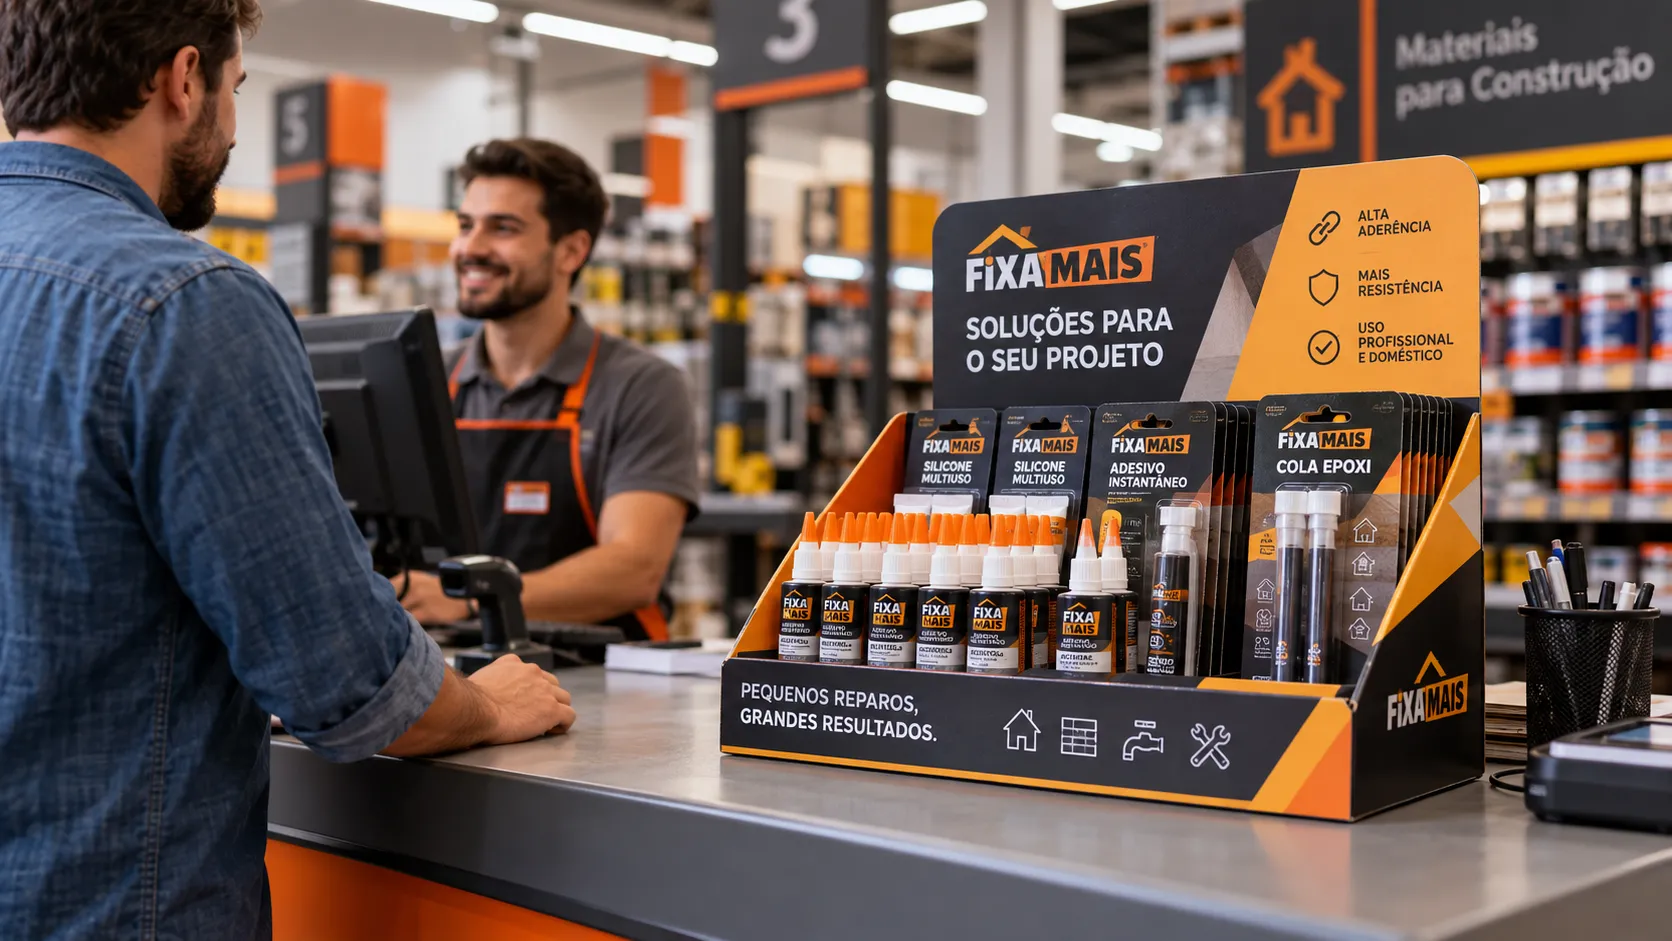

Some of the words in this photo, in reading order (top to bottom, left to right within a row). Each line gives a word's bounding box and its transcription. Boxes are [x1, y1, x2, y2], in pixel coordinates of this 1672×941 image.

[1396, 16, 1538, 69] Materiais
[1396, 77, 1465, 120] para
[1471, 46, 1654, 102] Construção
[1358, 208, 1389, 222] ALTA
[1358, 220, 1432, 237] ADERÊNCIA
[1358, 269, 1390, 281] MAIS
[1358, 279, 1443, 296] RESISTÊNCIA
[966, 306, 1095, 343] SOLUÇÕES
[1102, 307, 1173, 334] PARA
[1358, 322, 1384, 333] USO
[1358, 333, 1454, 348] PROFISSIONAL
[966, 350, 984, 372] O
[991, 347, 1038, 372] SEU
[1046, 342, 1164, 370] PROJETO
[1358, 352, 1366, 363] E
[1369, 348, 1443, 363] DOMÉSTICO
[923, 460, 972, 472] SILICONE
[1014, 460, 1066, 472] SILICONE
[1110, 462, 1165, 474] ADESIVO
[1276, 459, 1318, 474] COLA
[1323, 459, 1371, 474] EPOXI
[921, 473, 972, 484] MULTIUSO
[1012, 473, 1065, 485] MULTIUSO
[1108, 475, 1188, 488] INSTANTÂNEO
[783, 597, 807, 608] FIXA
[824, 600, 849, 611] FIXA
[873, 602, 901, 613] FIXA
[922, 605, 950, 616] FIXA
[974, 607, 1002, 618] FIXA
[1063, 611, 1094, 623] FIXA
[741, 682, 829, 705] PEQUENOS
[834, 690, 919, 716] REPAROS,
[740, 708, 818, 730] GRANDES
[822, 715, 938, 741] RESULTADOS.
